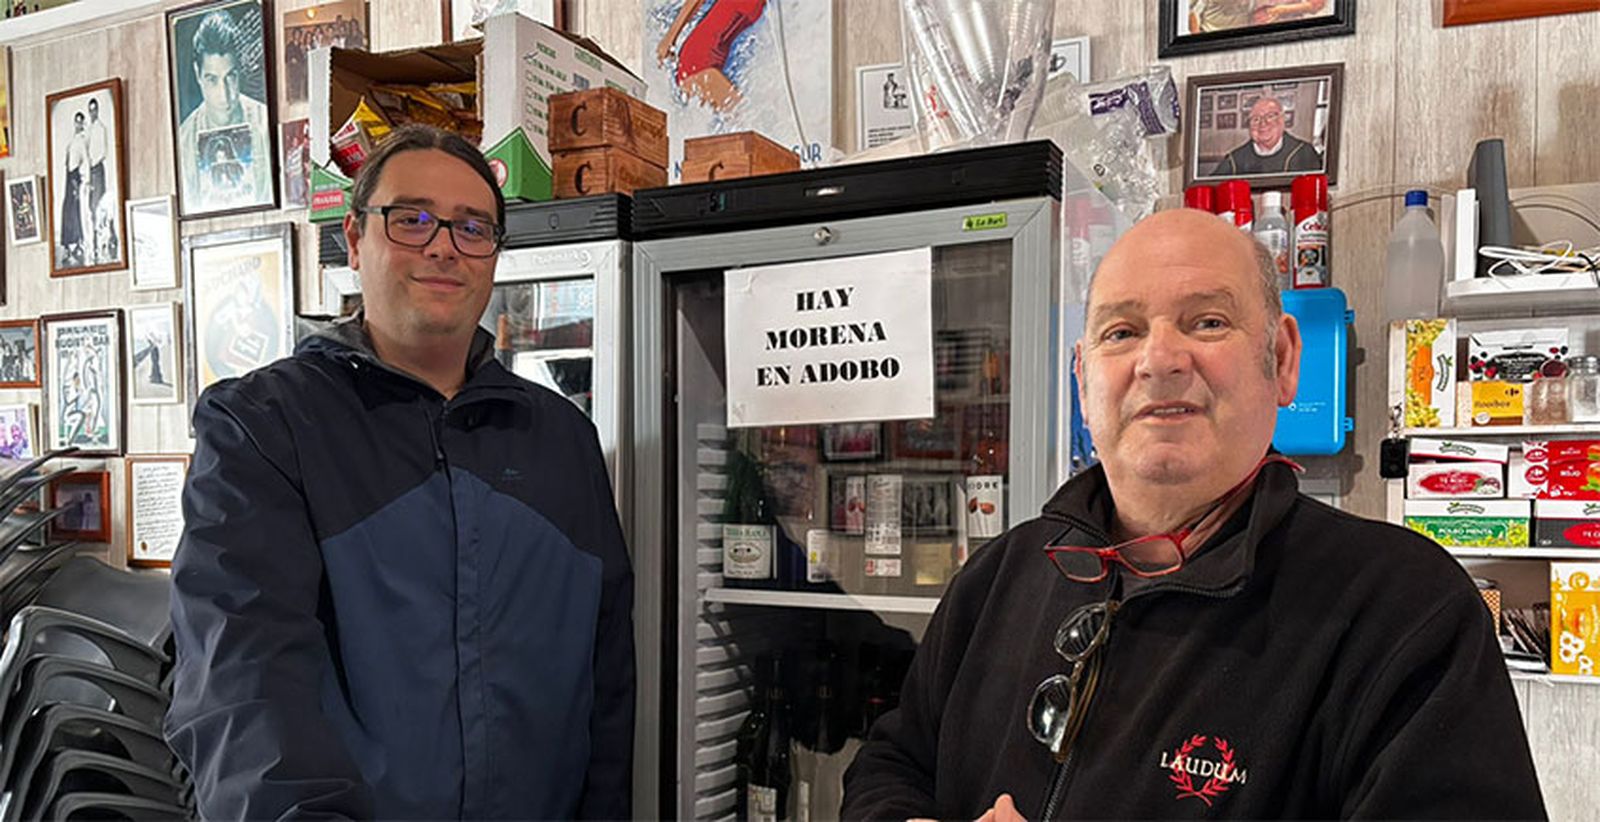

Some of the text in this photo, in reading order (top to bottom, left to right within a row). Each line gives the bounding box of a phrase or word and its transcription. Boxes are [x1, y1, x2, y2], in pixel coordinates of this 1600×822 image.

[571, 101, 588, 137] C
[575, 161, 592, 199] C
[796, 287, 854, 312] HAY
[765, 321, 887, 350] MORENA
[757, 357, 900, 387] EN ADOBO
[1160, 751, 1247, 784] LAUDUM
